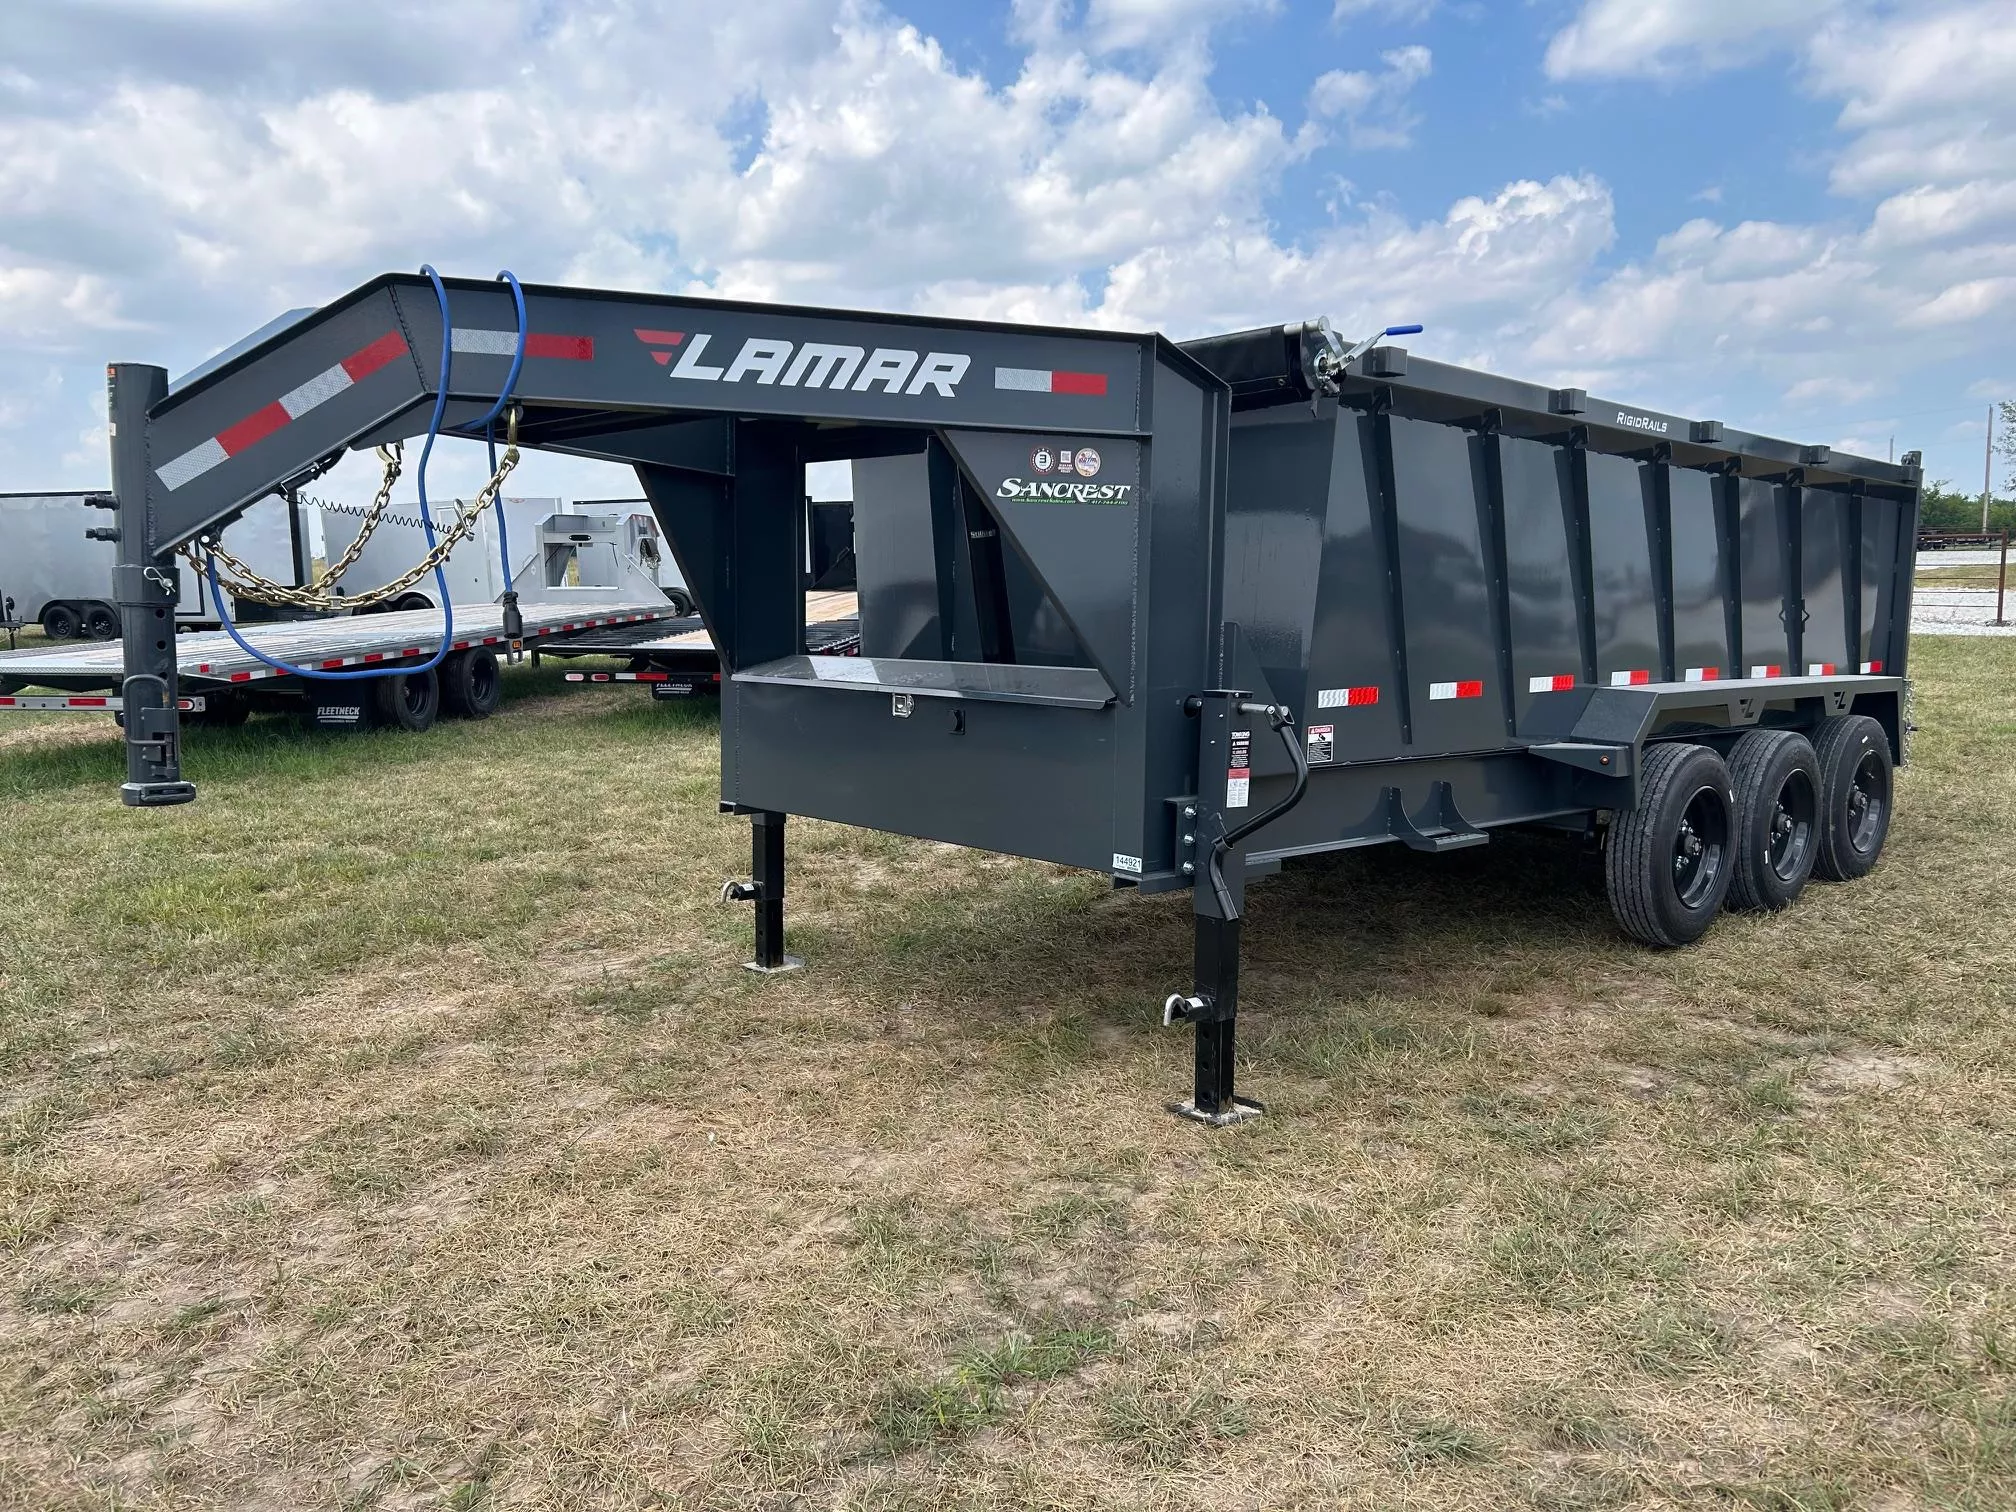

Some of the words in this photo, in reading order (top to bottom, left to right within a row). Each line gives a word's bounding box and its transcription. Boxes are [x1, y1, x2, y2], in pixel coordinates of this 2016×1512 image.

[669, 333, 972, 398] LAMAR
[996, 477, 1131, 503] SANCREST
[317, 706, 361, 716] FLEETNECK
[1116, 856, 1140, 868] 144921
